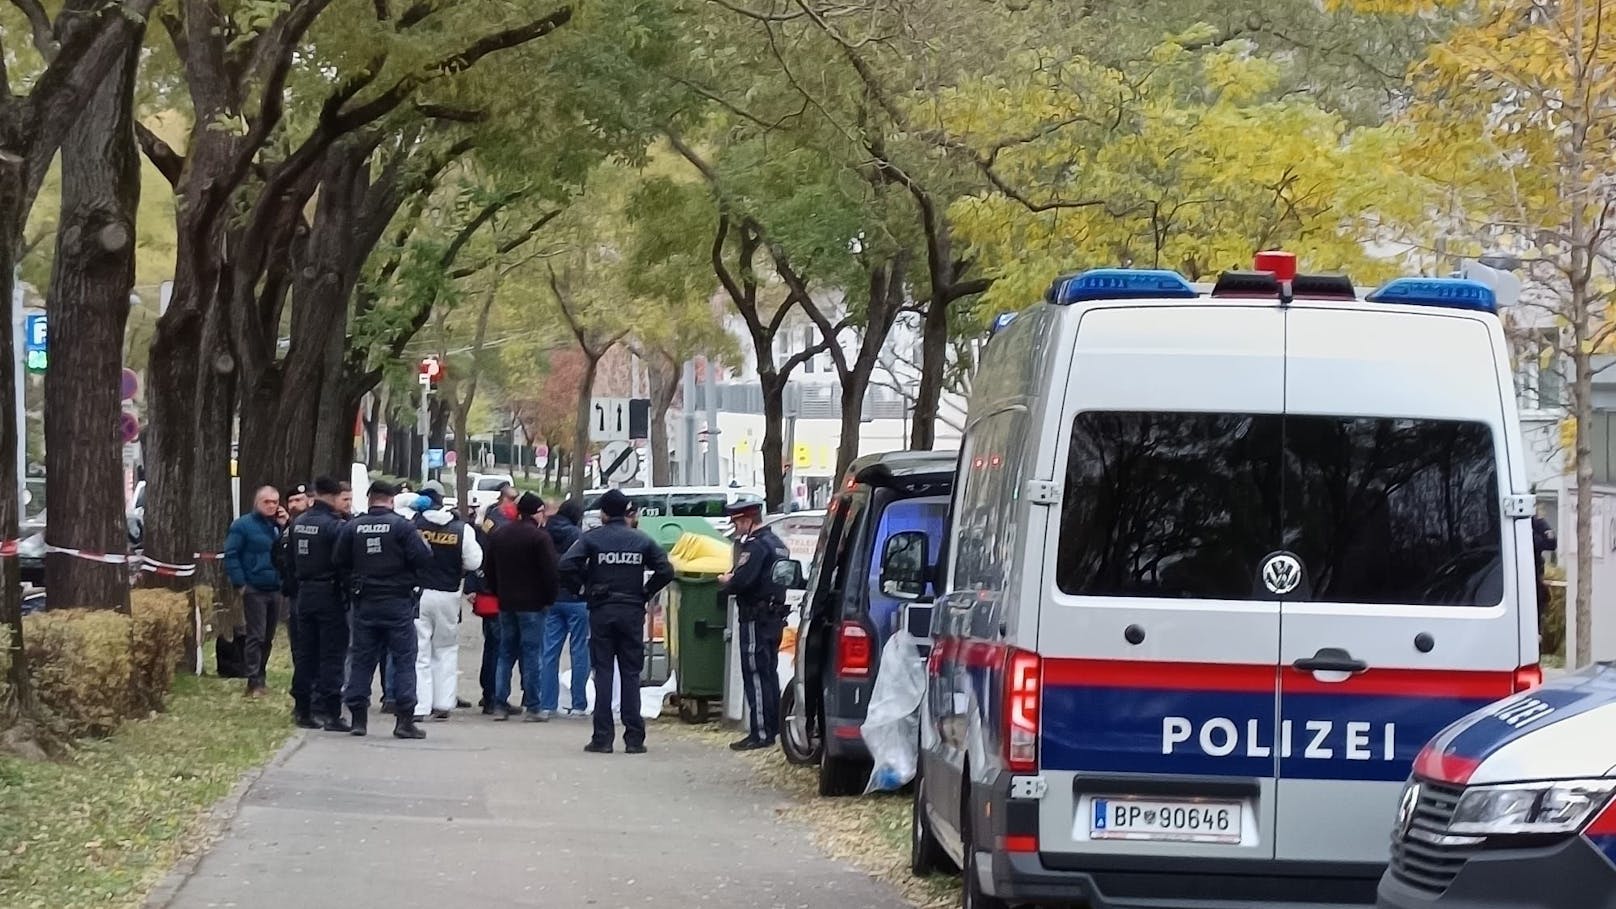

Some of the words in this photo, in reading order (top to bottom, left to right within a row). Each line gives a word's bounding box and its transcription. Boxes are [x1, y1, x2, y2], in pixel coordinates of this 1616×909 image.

[598, 551, 643, 565] POLIZEI
[1161, 716, 1395, 761] POLIZEI
[1114, 805, 1141, 827] BP
[1159, 806, 1229, 831] 90646
